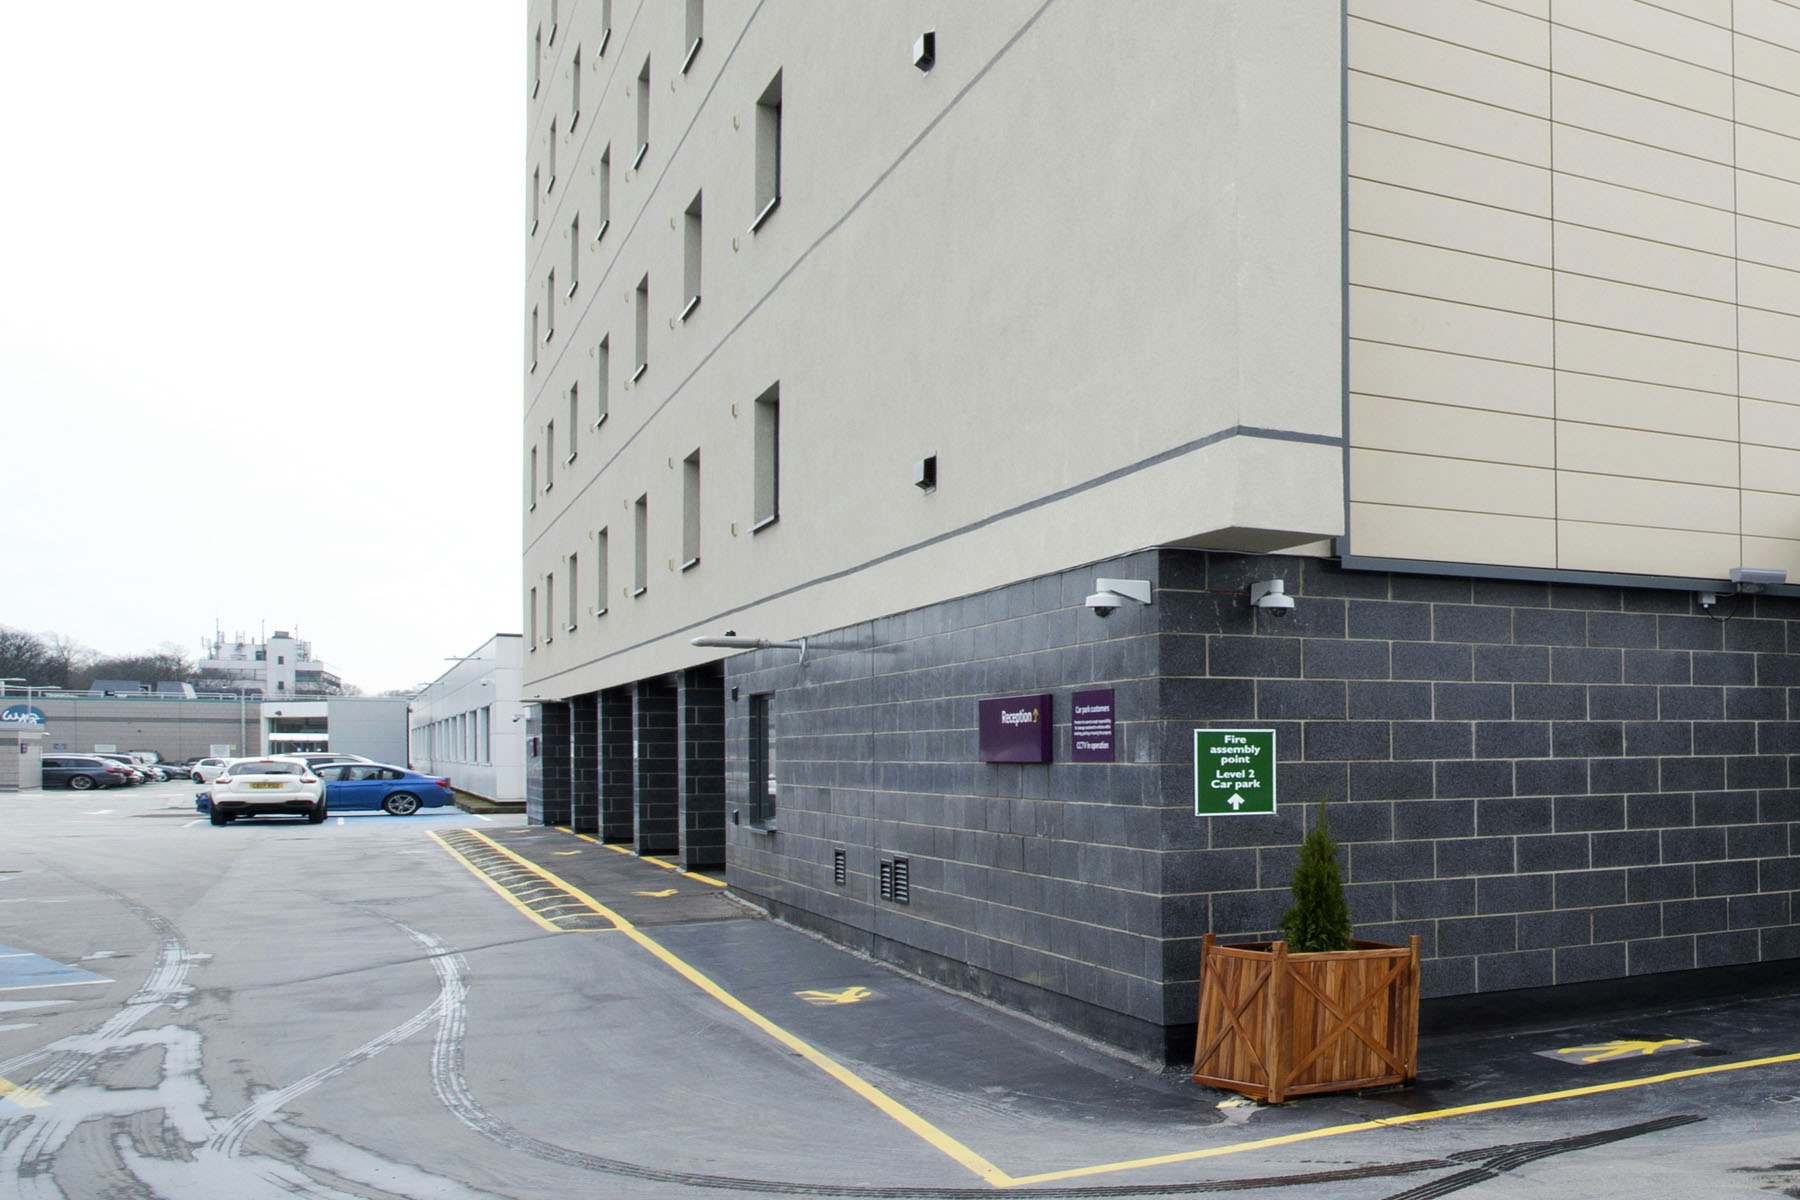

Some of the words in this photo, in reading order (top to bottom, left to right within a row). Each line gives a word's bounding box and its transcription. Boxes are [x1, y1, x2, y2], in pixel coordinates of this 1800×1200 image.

[1001, 709, 1032, 727] Reception
[1224, 735, 1247, 744] Fire
[1209, 745, 1261, 756] assembly
[1220, 755, 1251, 766] point
[1216, 769, 1246, 779] Level
[1248, 769, 1255, 778] 2
[1210, 779, 1232, 789] Car
[1234, 779, 1261, 790] park
